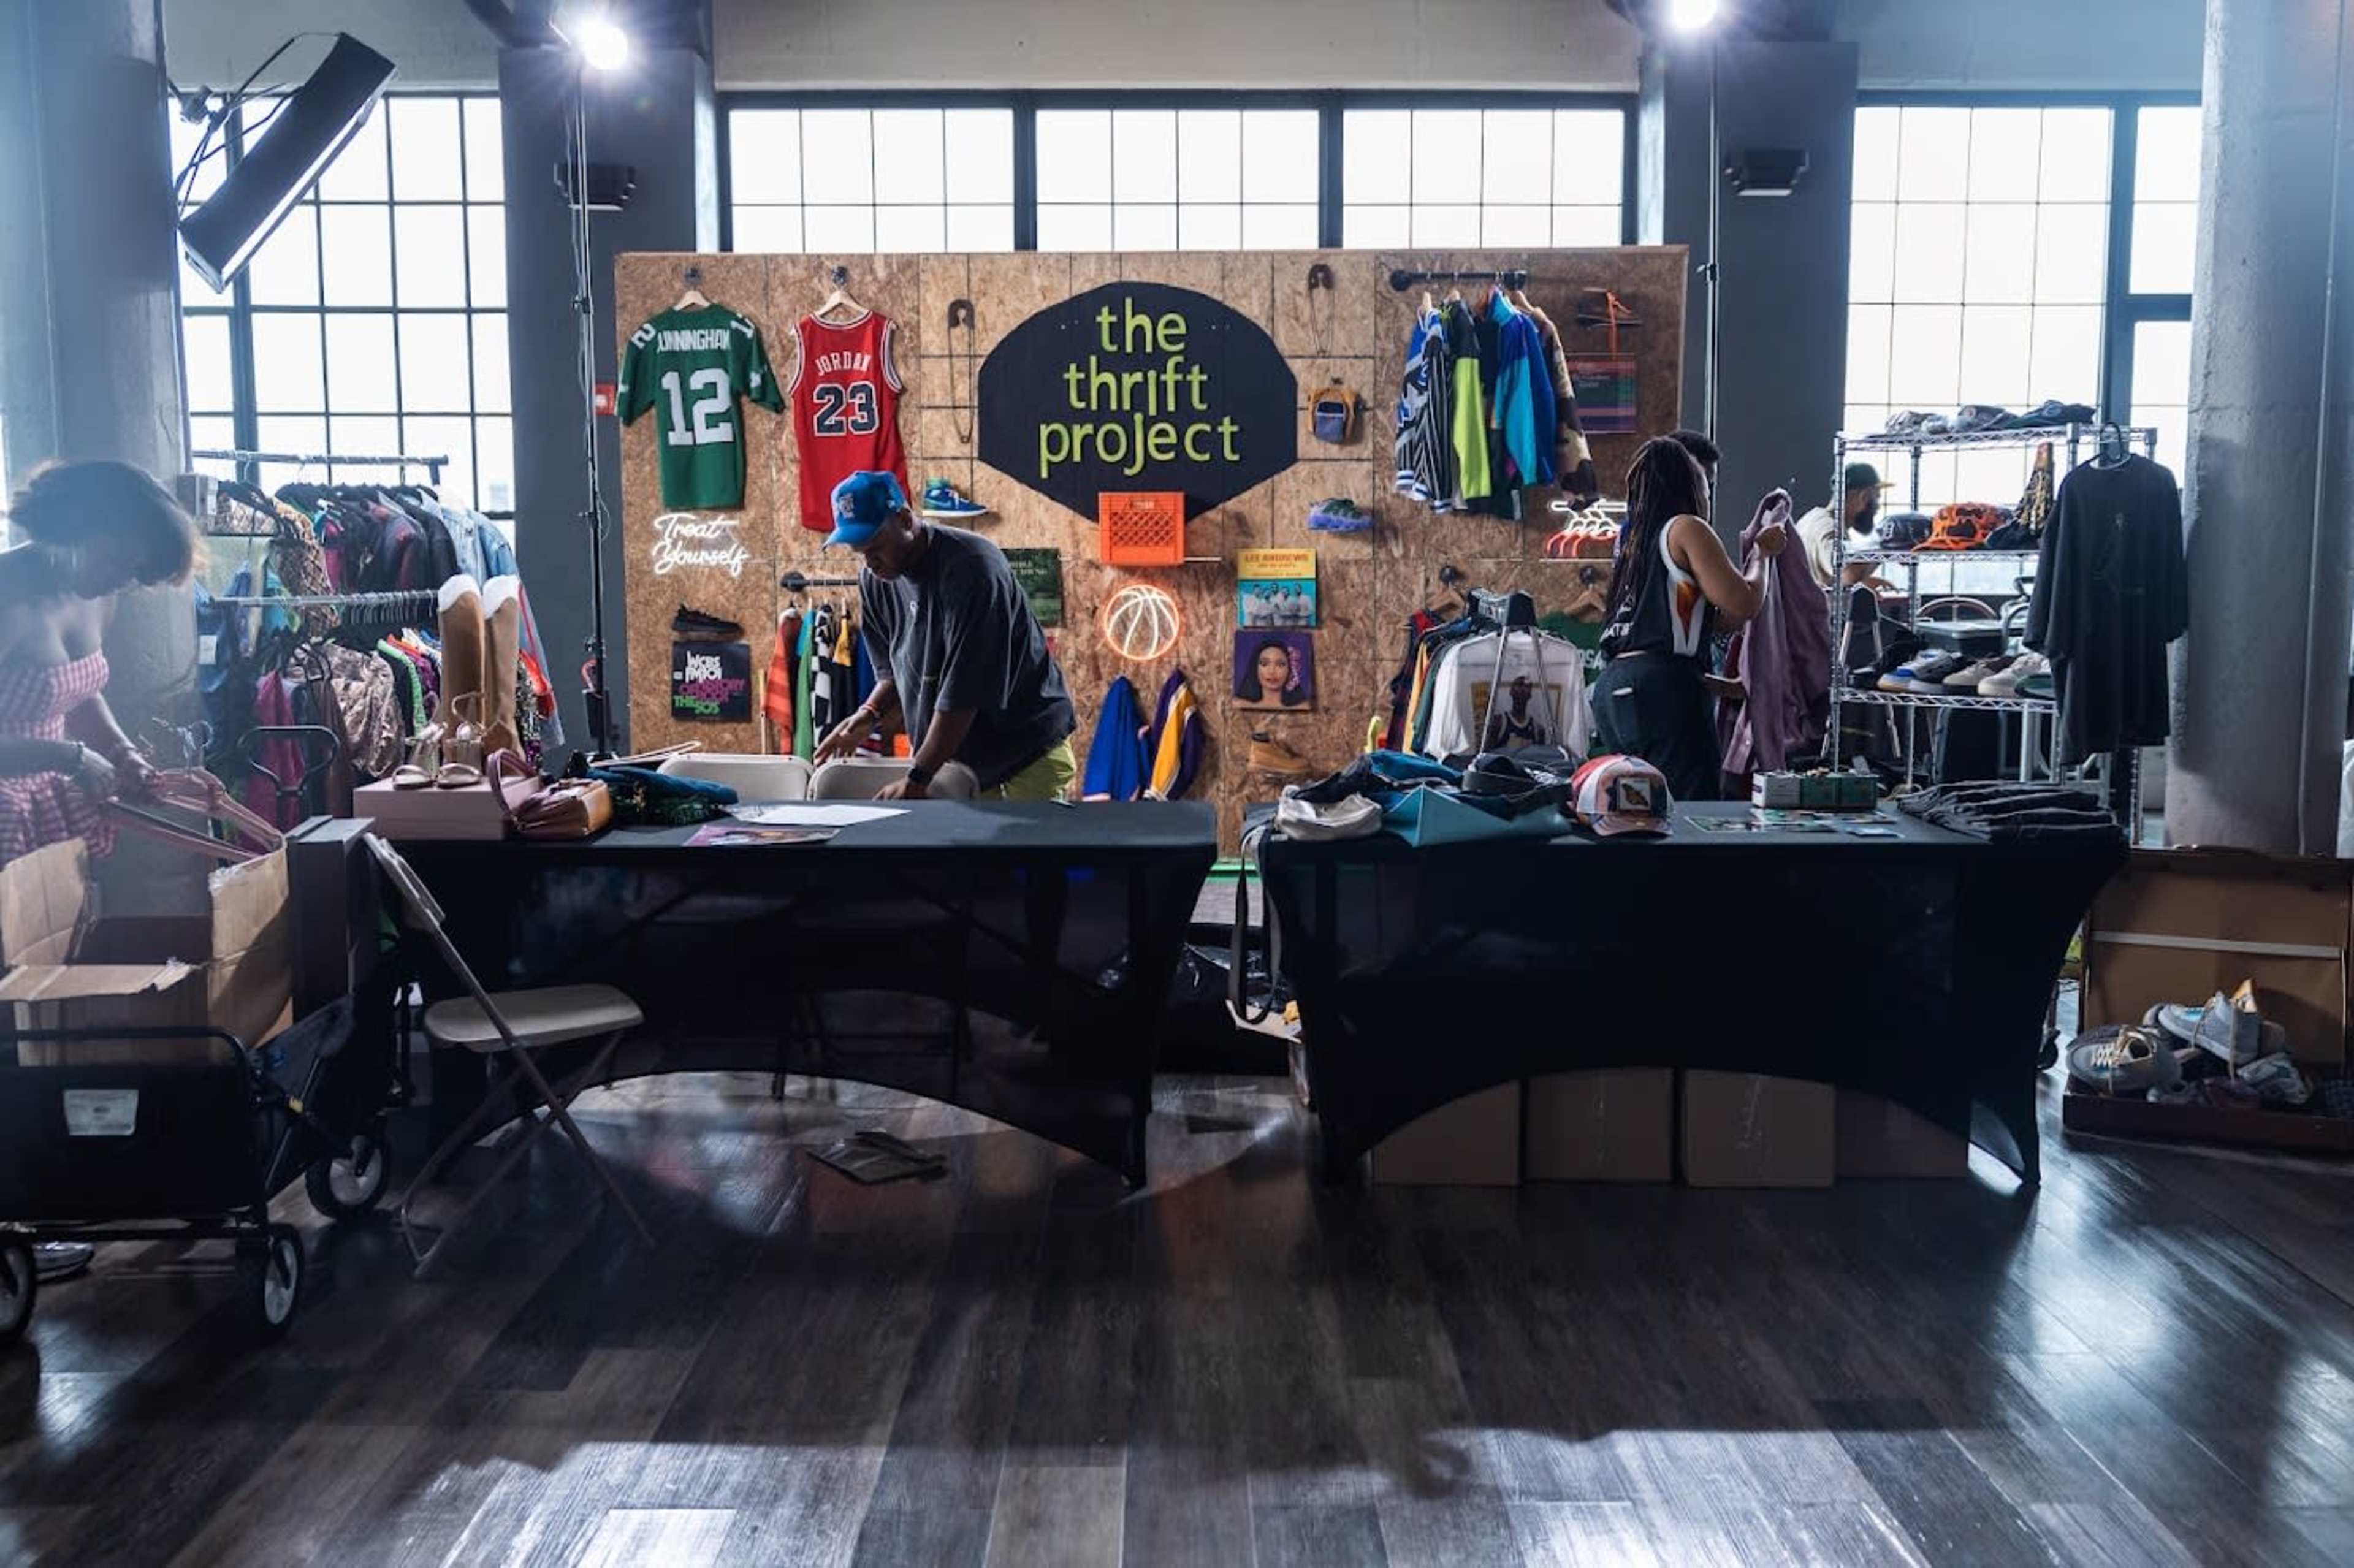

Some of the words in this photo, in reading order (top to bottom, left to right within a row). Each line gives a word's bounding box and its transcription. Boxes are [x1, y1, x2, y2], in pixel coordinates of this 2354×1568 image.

[1095, 297, 1187, 354] the
[815, 351, 871, 376] JORDAN
[1063, 354, 1208, 416] thrift
[661, 368, 734, 446] 12
[813, 381, 880, 436] 23
[1040, 413, 1240, 479] project
[654, 512, 740, 540] Treat
[652, 540, 751, 578] Yourself
